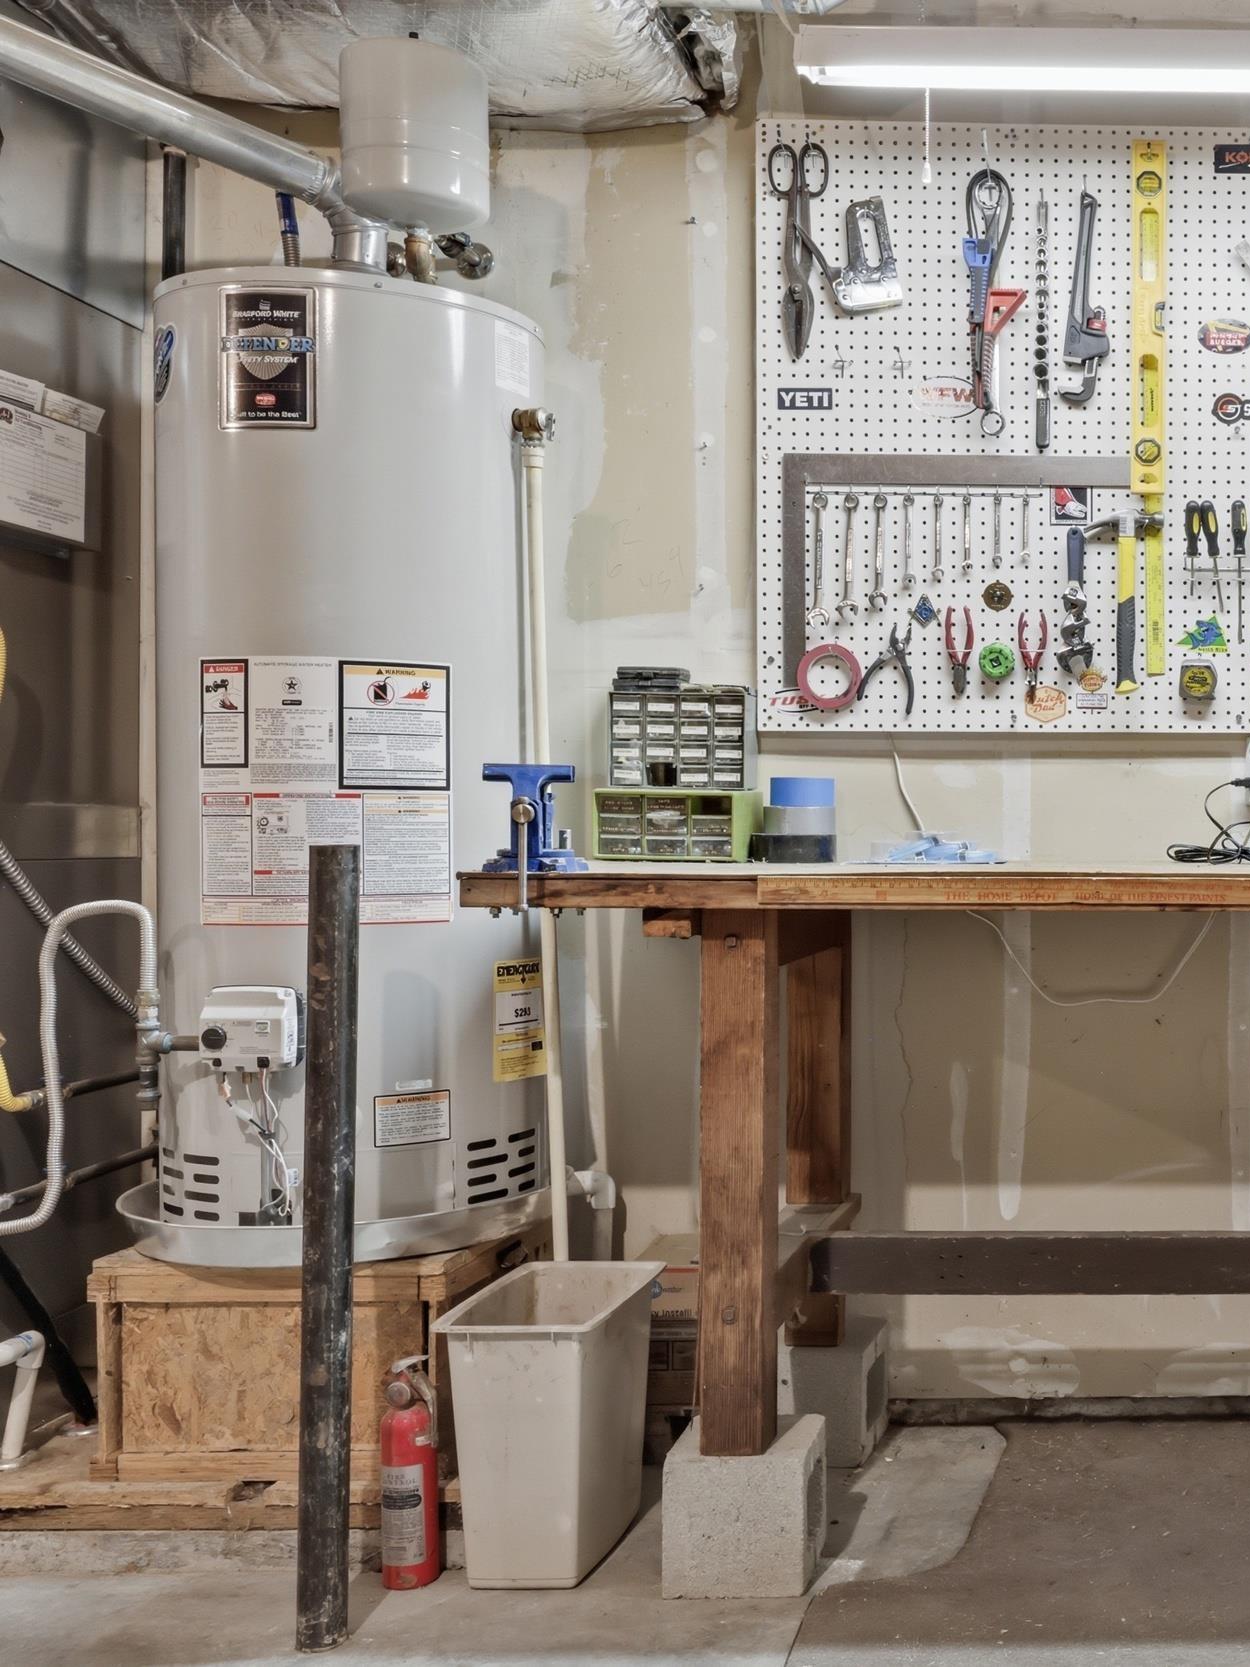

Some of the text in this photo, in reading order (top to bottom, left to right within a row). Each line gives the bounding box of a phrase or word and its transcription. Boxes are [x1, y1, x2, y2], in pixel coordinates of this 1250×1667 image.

[221, 336, 314, 352] DEFENDER
[780, 391, 830, 407] YETI
[769, 696, 810, 706] TUS
[944, 891, 969, 901] THE
[976, 891, 1012, 901] HOME
[1189, 892, 1226, 902] PAINTS
